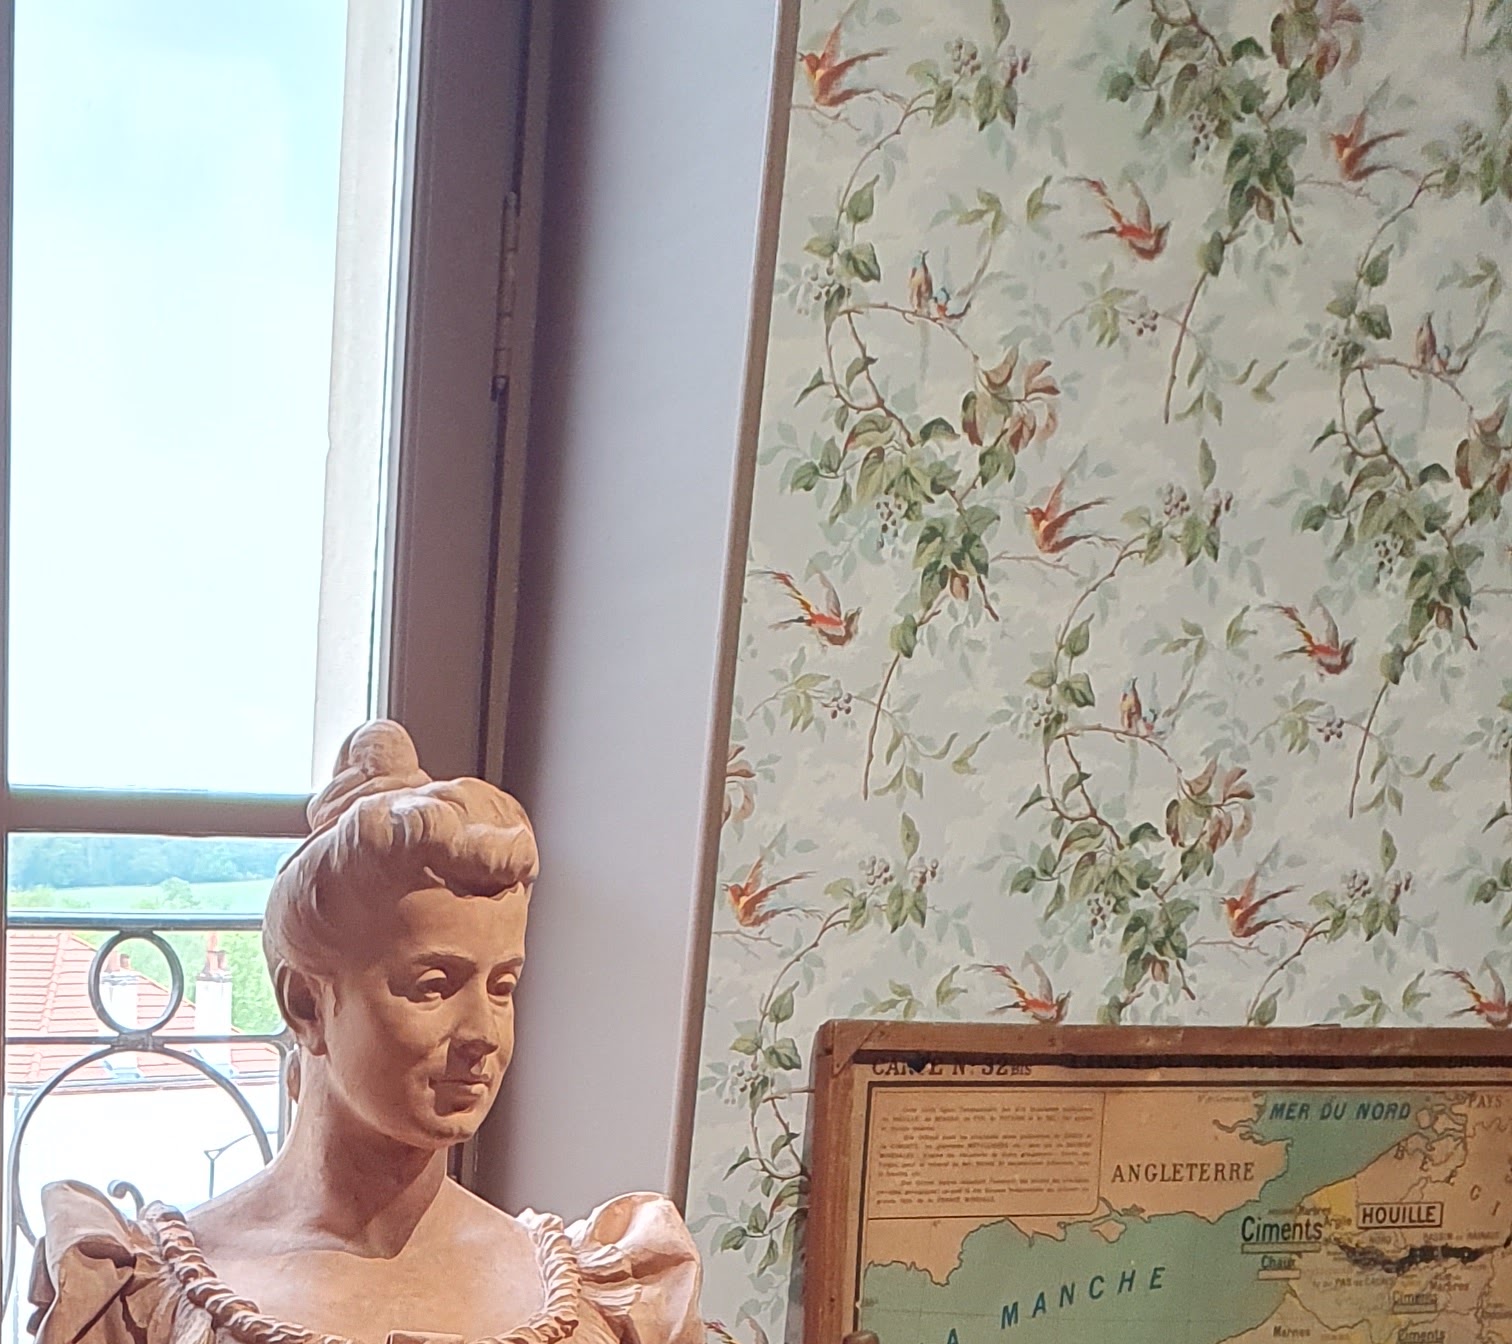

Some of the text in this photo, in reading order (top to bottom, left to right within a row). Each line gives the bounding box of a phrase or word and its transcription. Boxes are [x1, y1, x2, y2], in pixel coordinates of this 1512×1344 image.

[1269, 1101, 1411, 1120] MER DU NORD
[1111, 1162, 1256, 1183] ANGLETERRE
[1361, 1205, 1437, 1224] HOUILLE
[1241, 1215, 1323, 1242] Ciments
[1001, 1267, 1165, 1329] MANCHE
